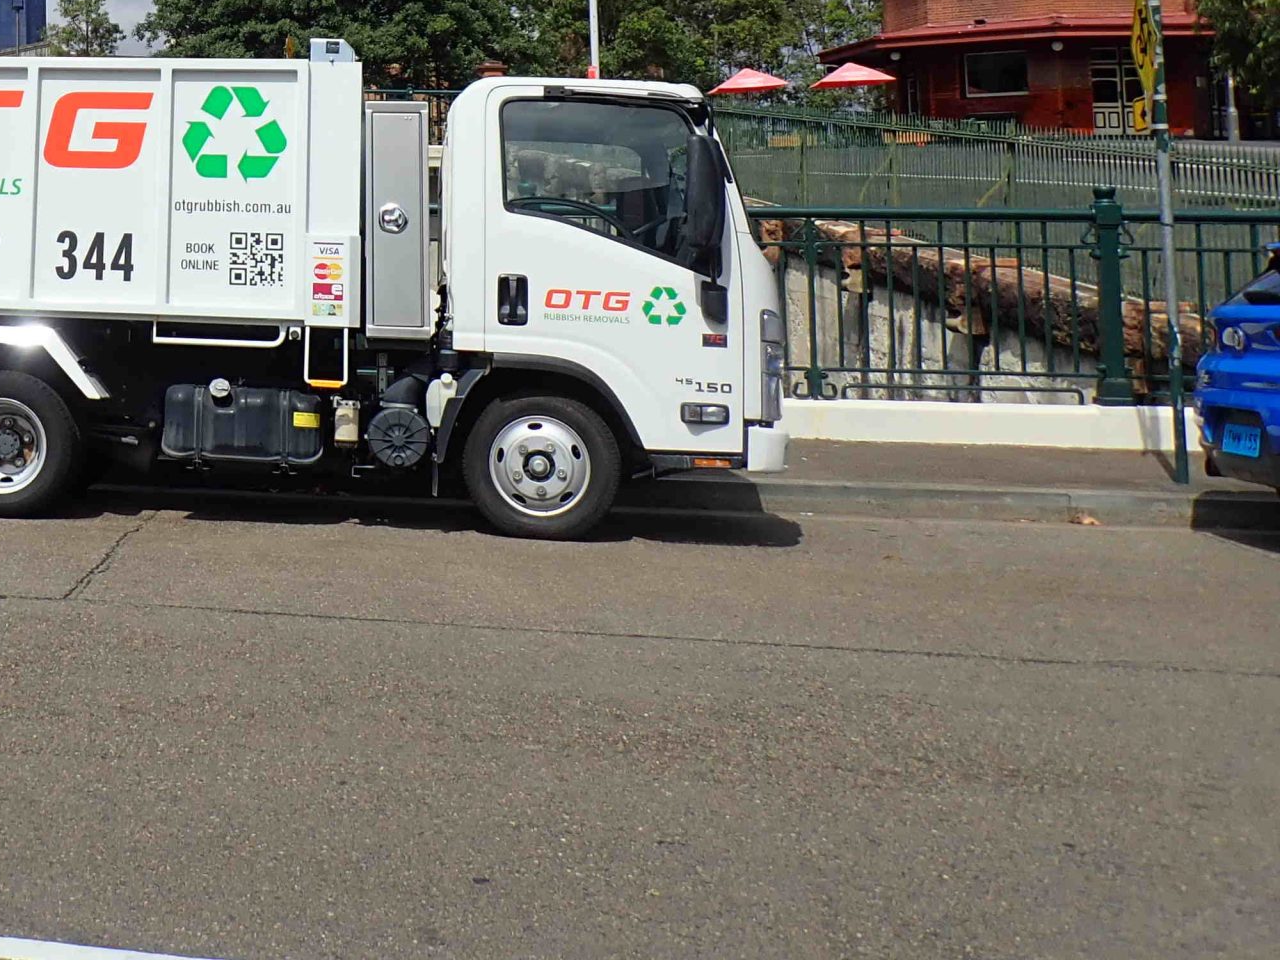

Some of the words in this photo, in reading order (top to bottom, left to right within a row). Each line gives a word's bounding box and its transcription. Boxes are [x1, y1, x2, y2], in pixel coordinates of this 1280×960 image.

[174, 199, 292, 214] otgrubbish.com.au
[185, 243, 216, 254] BOOK
[319, 247, 340, 255] VISA
[55, 230, 134, 282] 344
[180, 259, 220, 271] ONLINE
[544, 289, 631, 312] OTG
[543, 312, 581, 322] RUBBISH
[583, 315, 630, 325] REMOVALS
